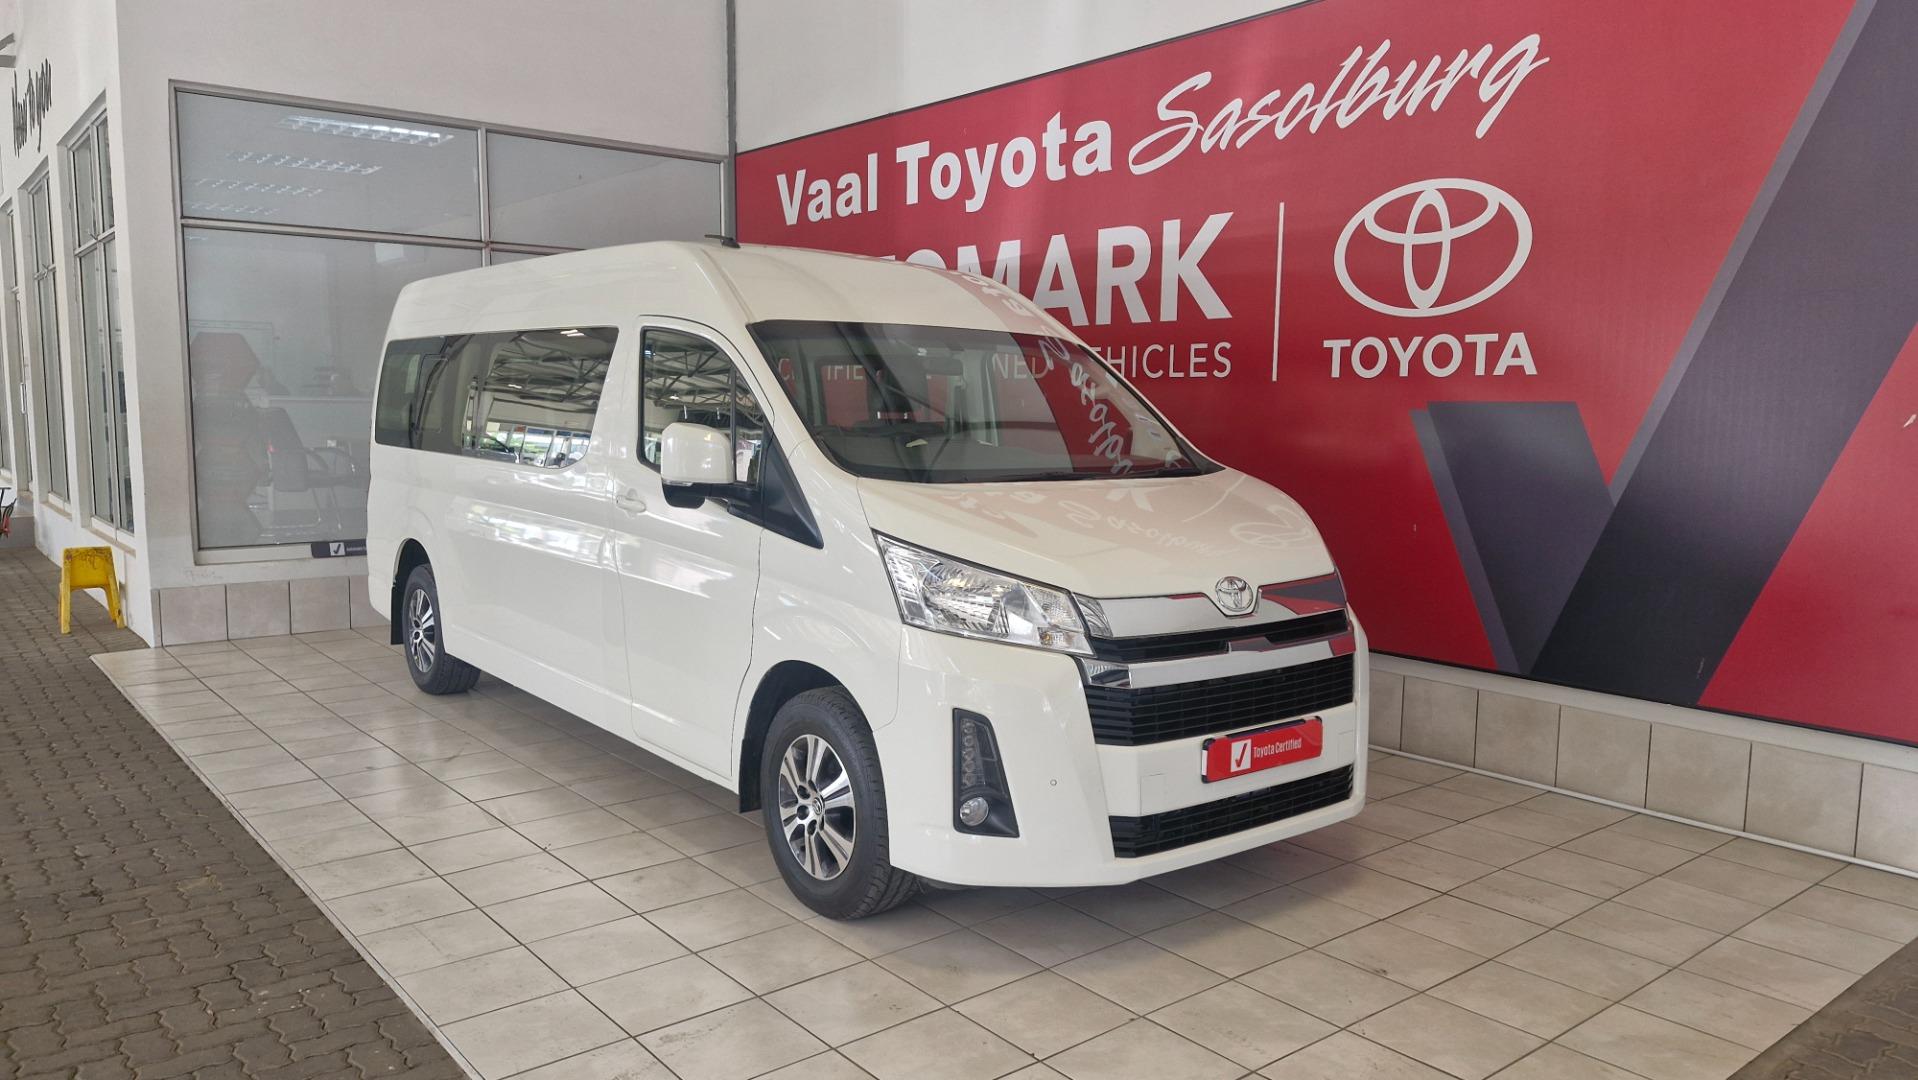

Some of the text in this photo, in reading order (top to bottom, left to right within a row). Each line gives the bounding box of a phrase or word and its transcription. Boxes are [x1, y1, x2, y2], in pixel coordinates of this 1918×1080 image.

[776, 33, 1550, 226] Vaal Toyota Sasolburg
[1095, 341, 1232, 380] HICLES
[1323, 332, 1538, 379] TOYOTA
[1252, 737, 1303, 759] Toyota Certified
